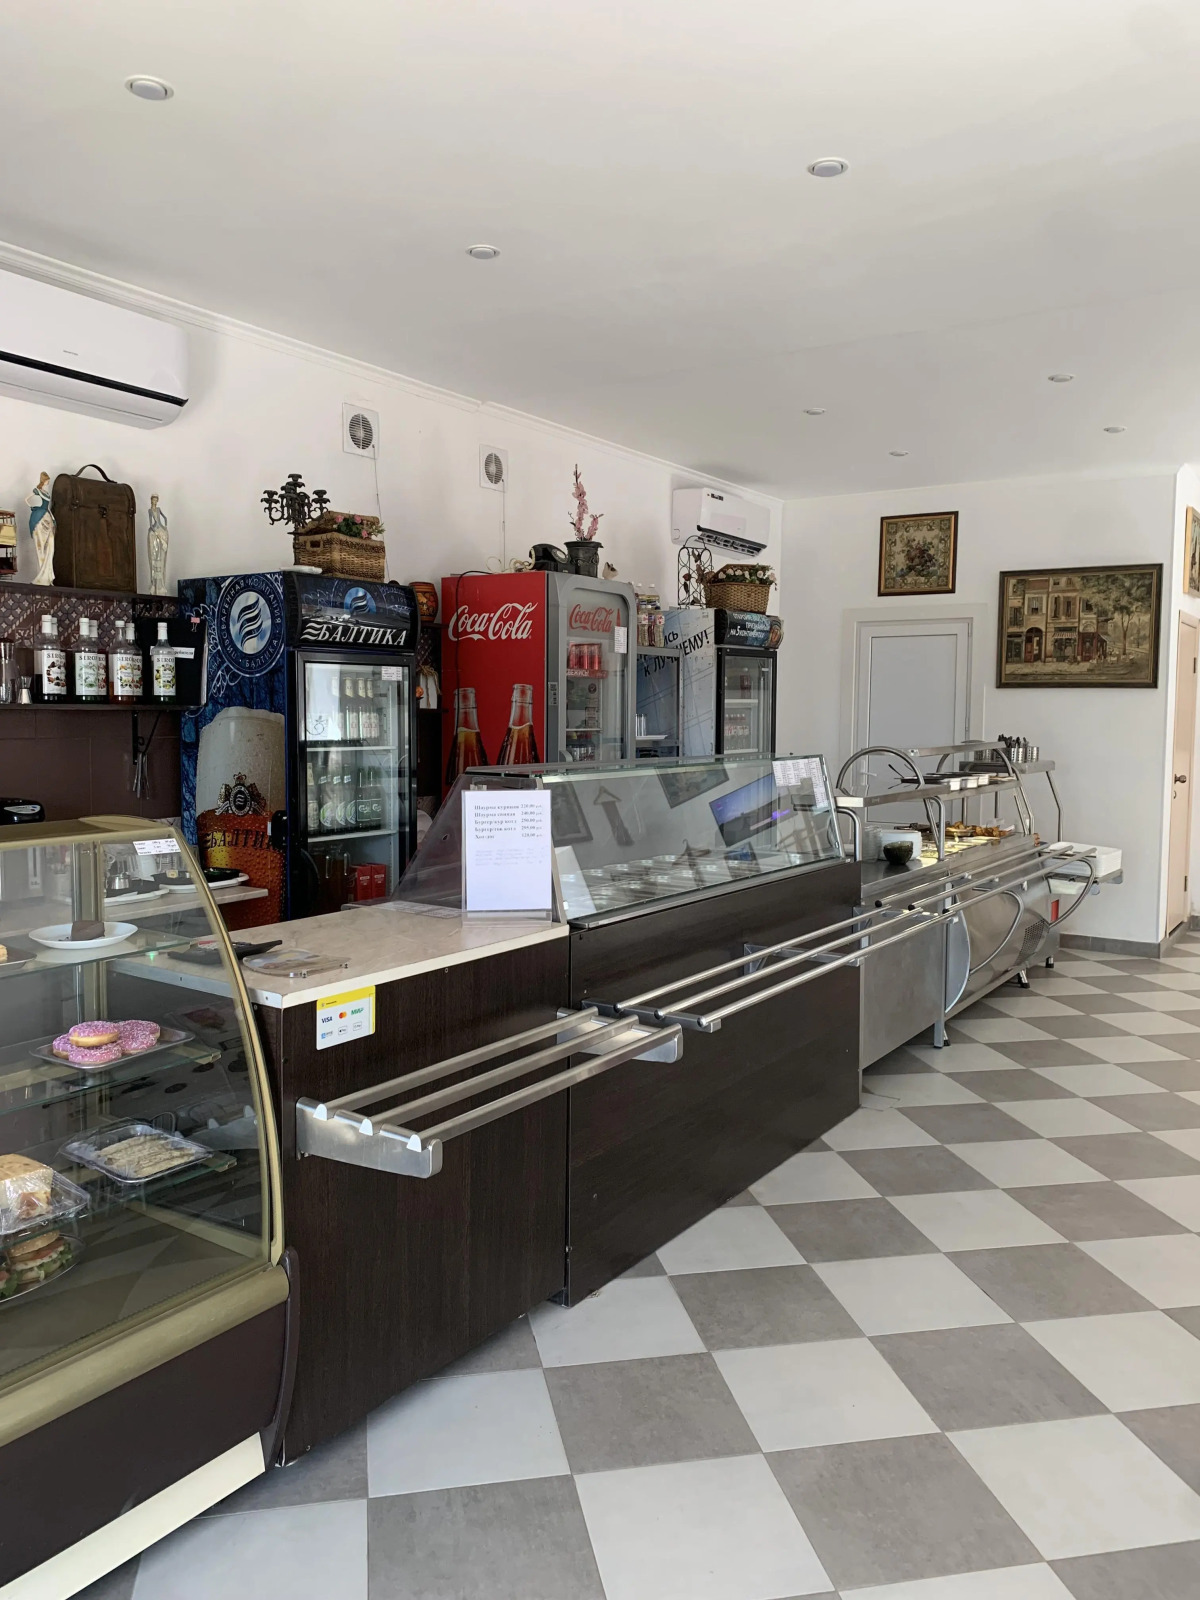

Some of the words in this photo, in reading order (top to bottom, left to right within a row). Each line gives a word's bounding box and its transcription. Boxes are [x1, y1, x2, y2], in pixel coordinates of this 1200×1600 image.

[448, 602, 538, 641] Coca-Cola
[569, 603, 614, 633] Coca-Cola
[317, 625, 407, 646] БАЛТИКА
[321, 1016, 333, 1024] VISA
